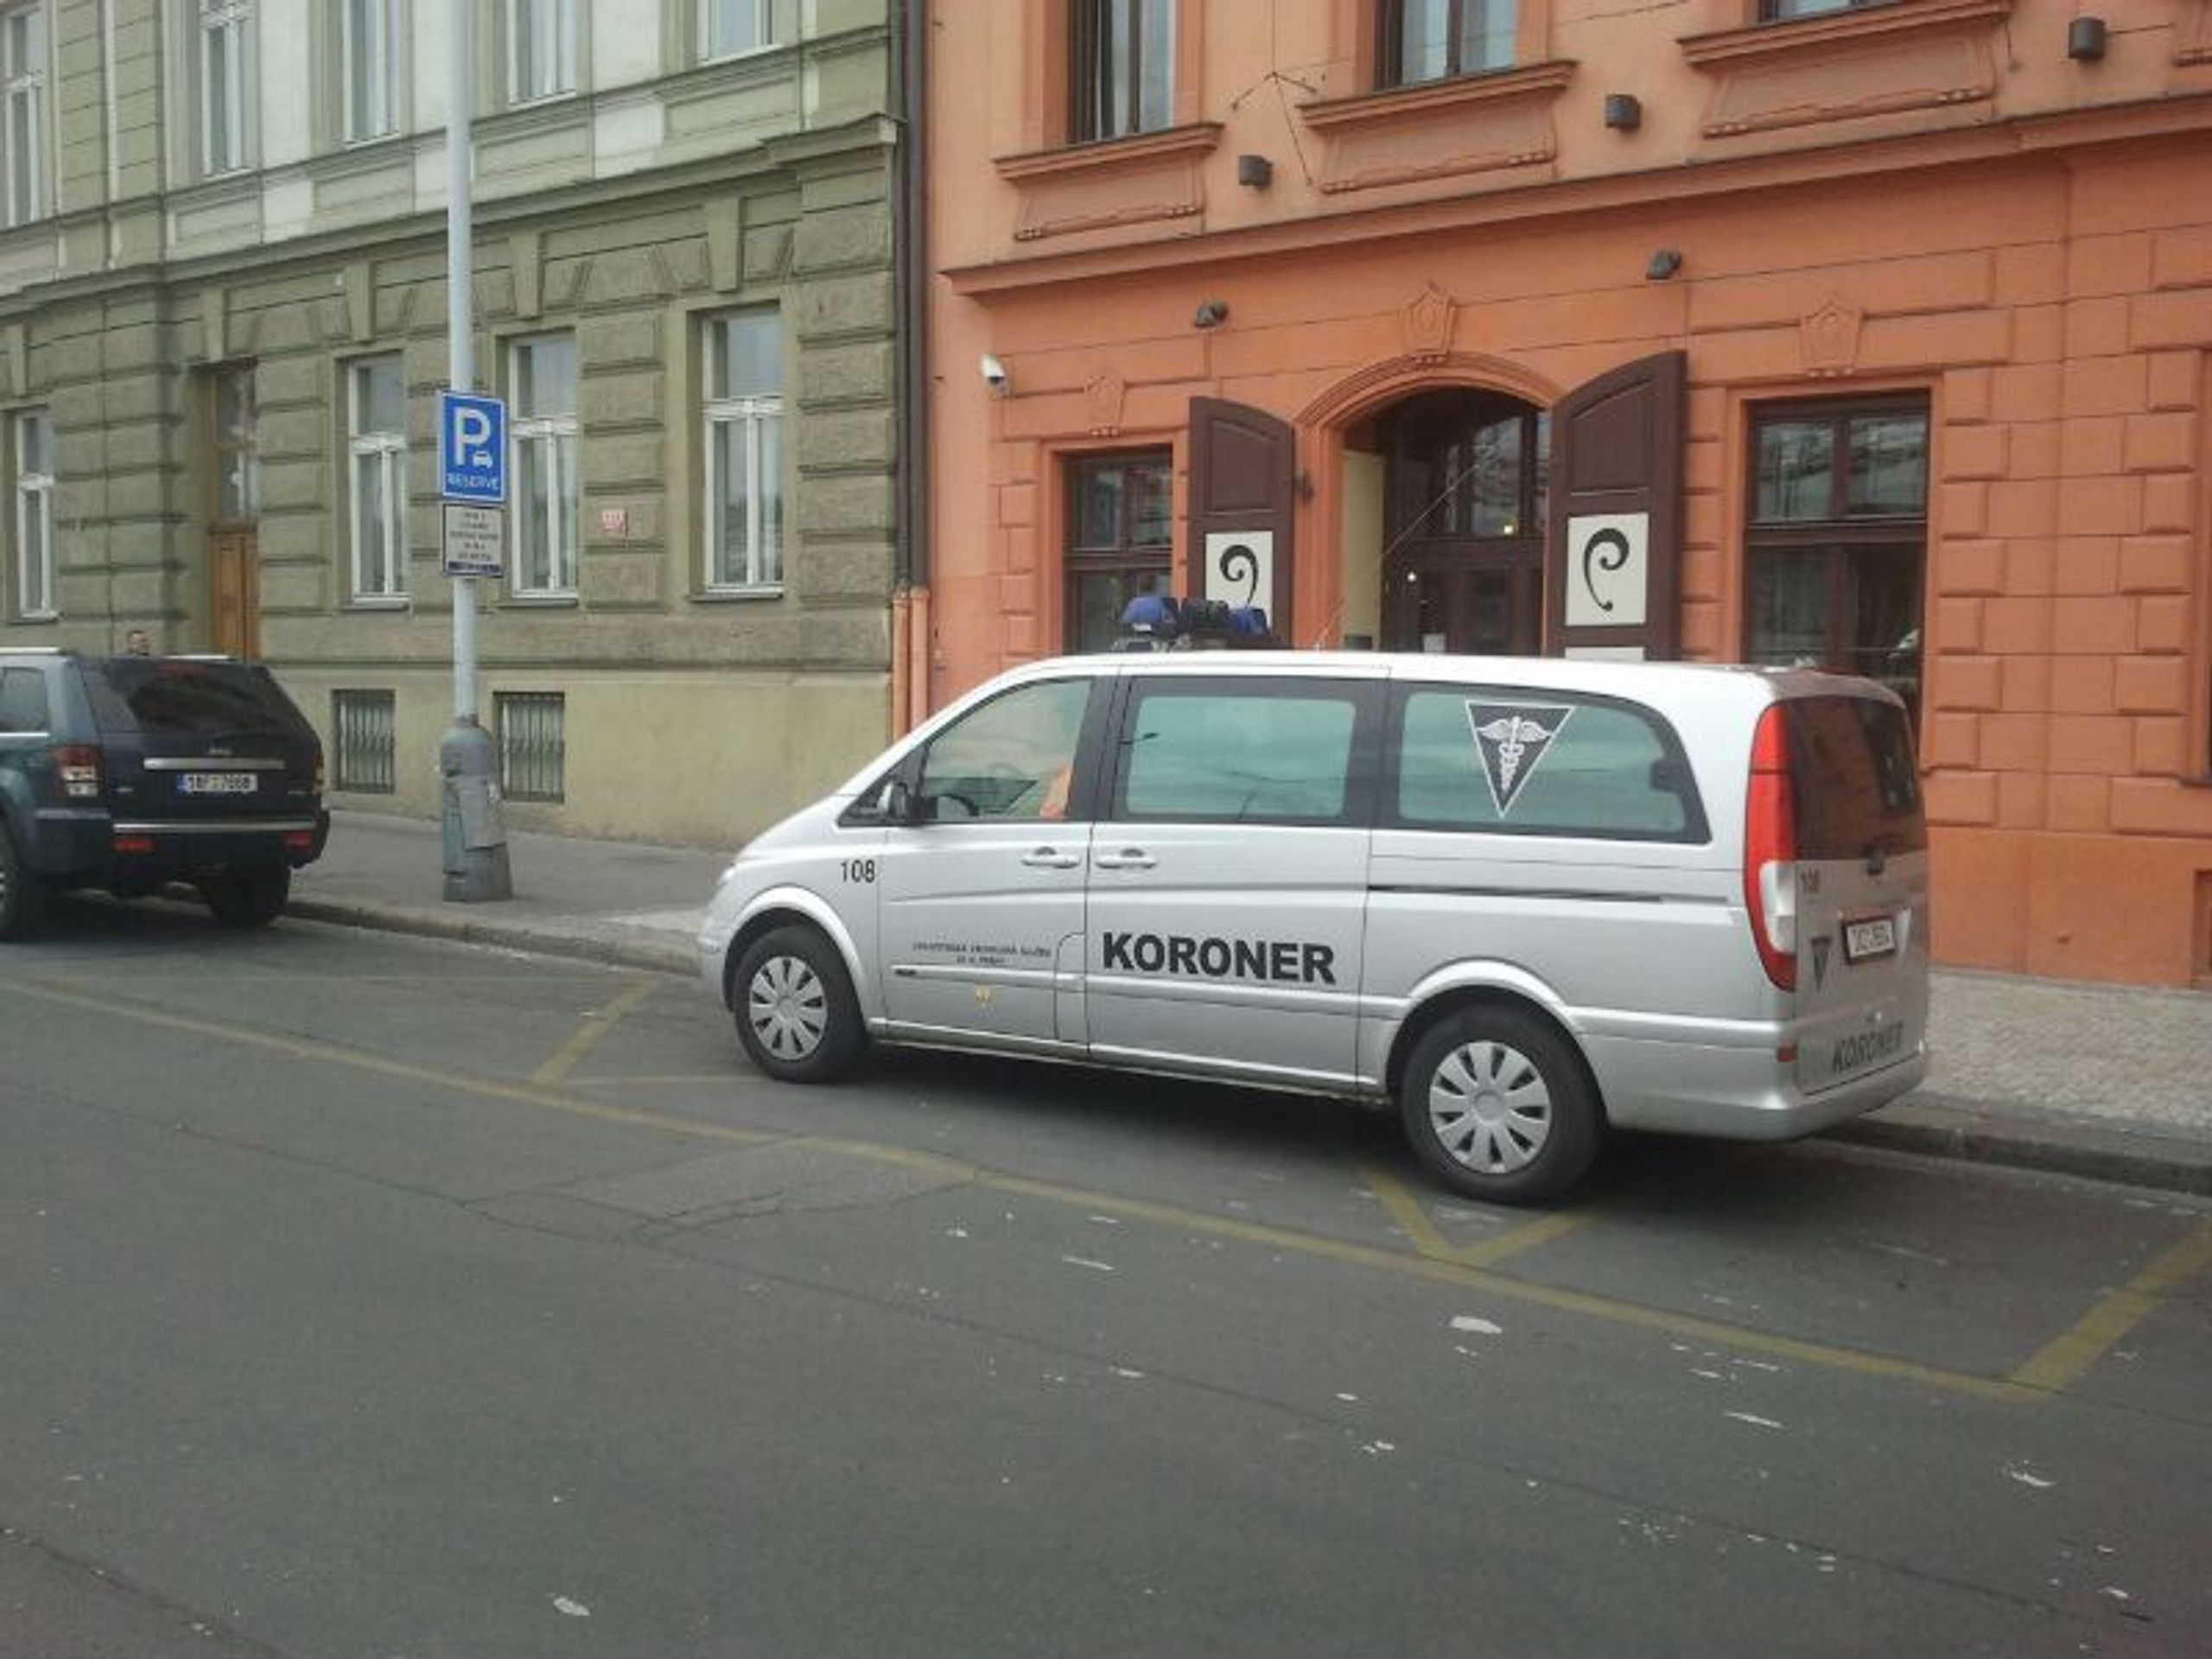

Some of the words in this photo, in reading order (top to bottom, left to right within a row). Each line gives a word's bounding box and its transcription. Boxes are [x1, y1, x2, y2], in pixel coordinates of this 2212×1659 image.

[454, 406, 492, 467] P
[840, 859, 875, 883] 108
[1103, 931, 1337, 985] KORONER
